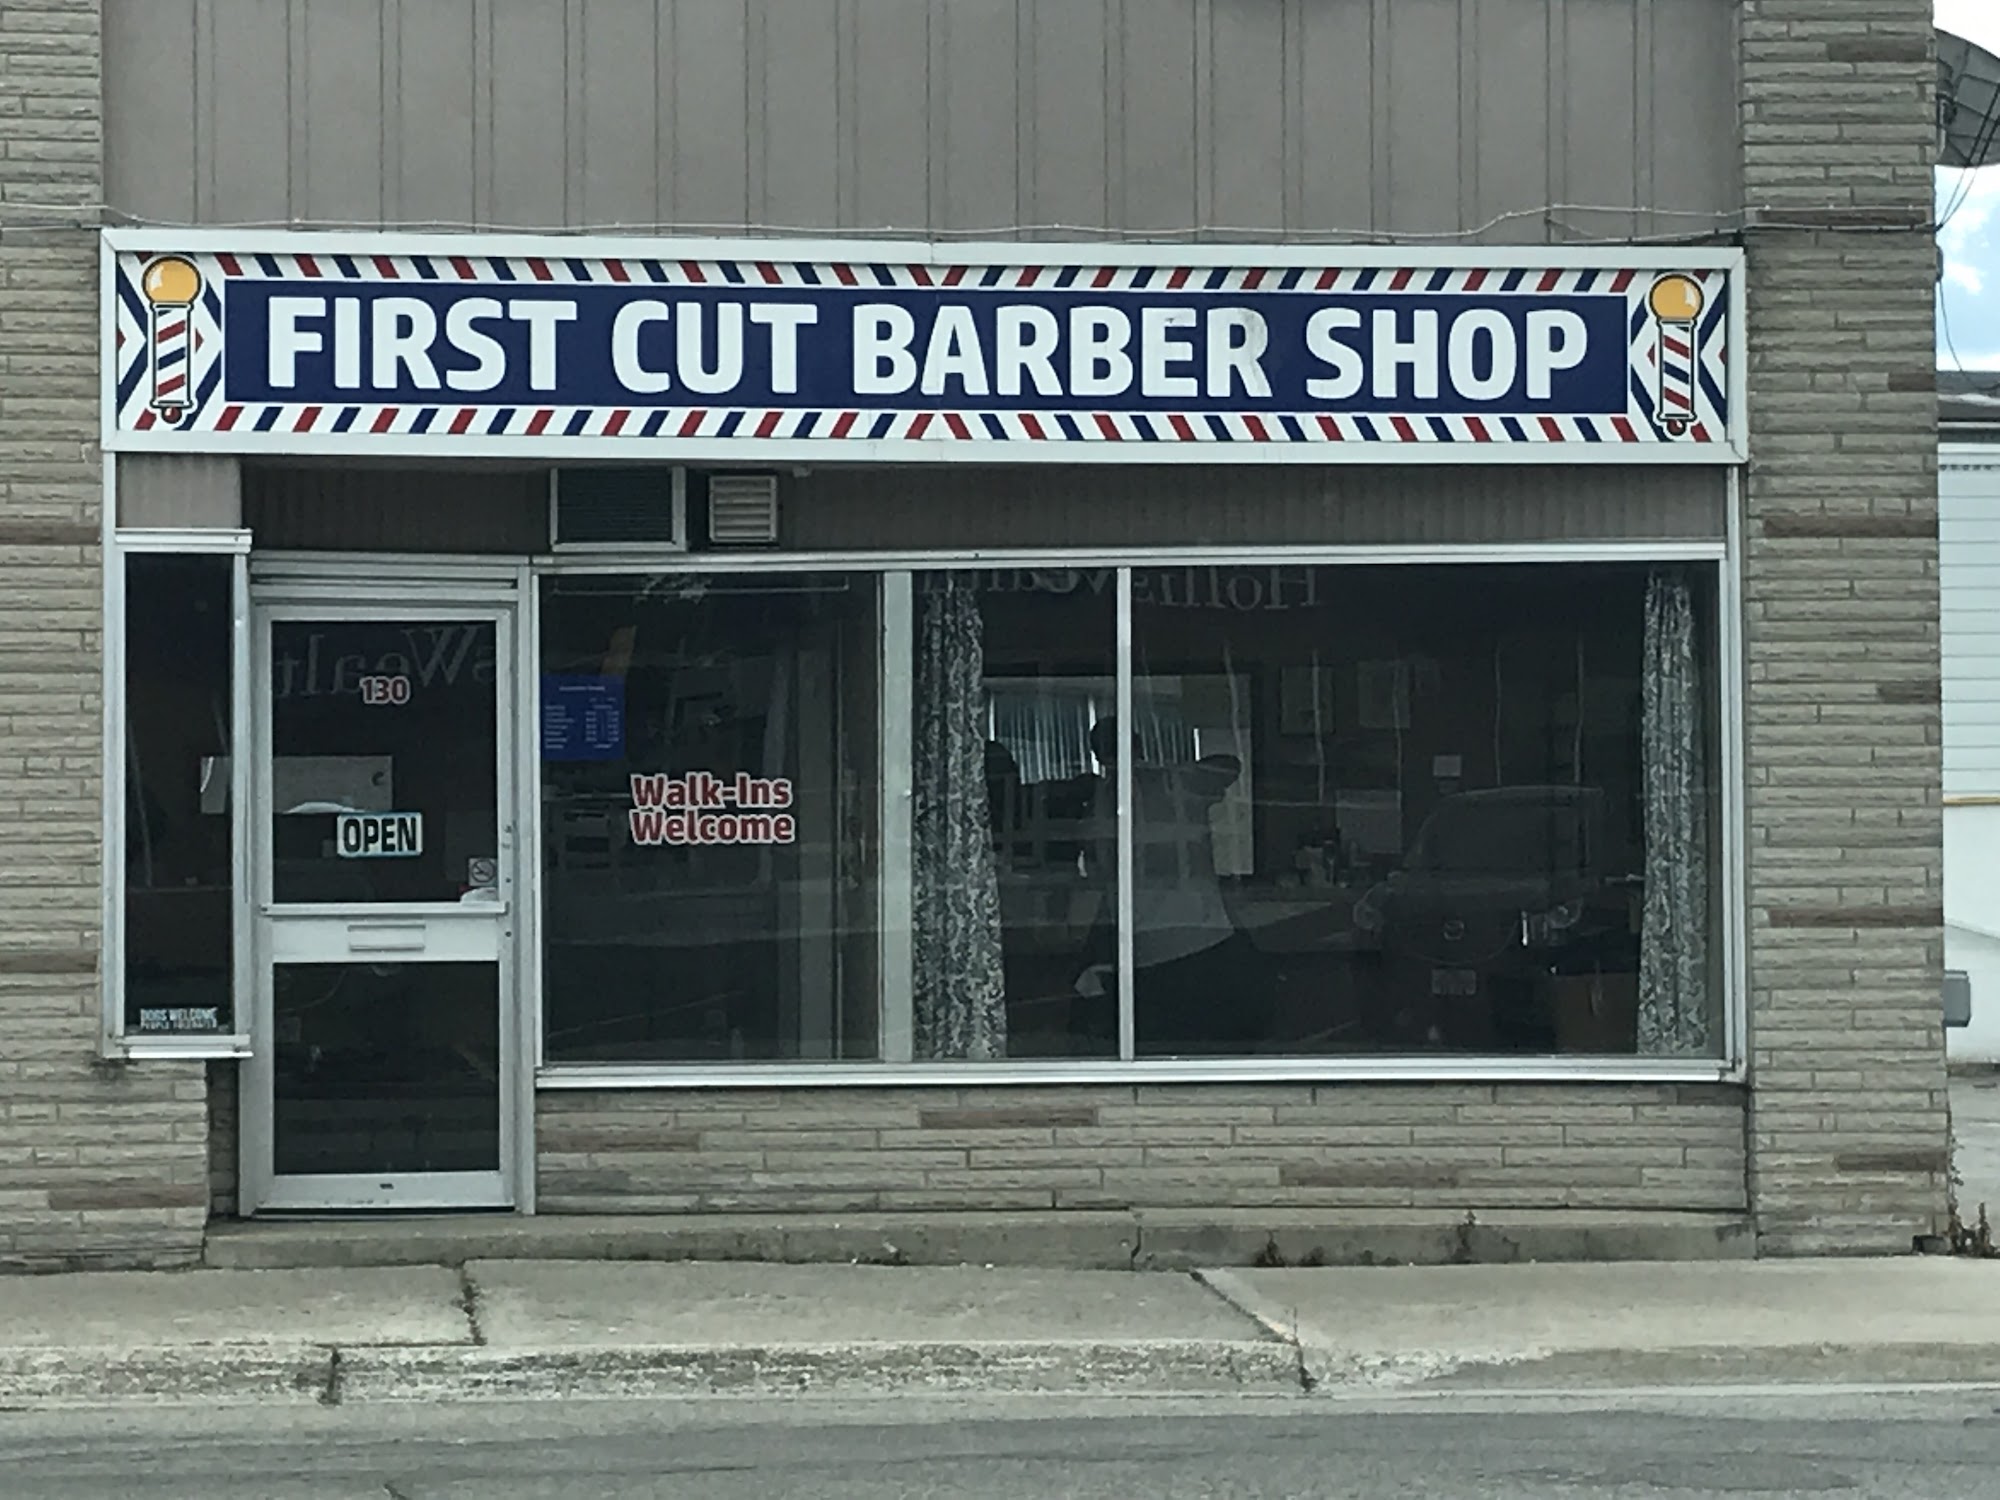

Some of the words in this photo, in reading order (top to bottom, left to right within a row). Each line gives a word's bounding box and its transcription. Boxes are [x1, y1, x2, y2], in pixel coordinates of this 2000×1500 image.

[268, 296, 578, 392] FIRST
[611, 299, 818, 394] CUT
[853, 303, 1273, 398] BARBER
[1306, 306, 1588, 400] SHOP
[359, 676, 411, 704] 130
[630, 771, 793, 809] Walk-Ins
[343, 817, 417, 853] OPEN
[629, 808, 796, 846] Welcome
